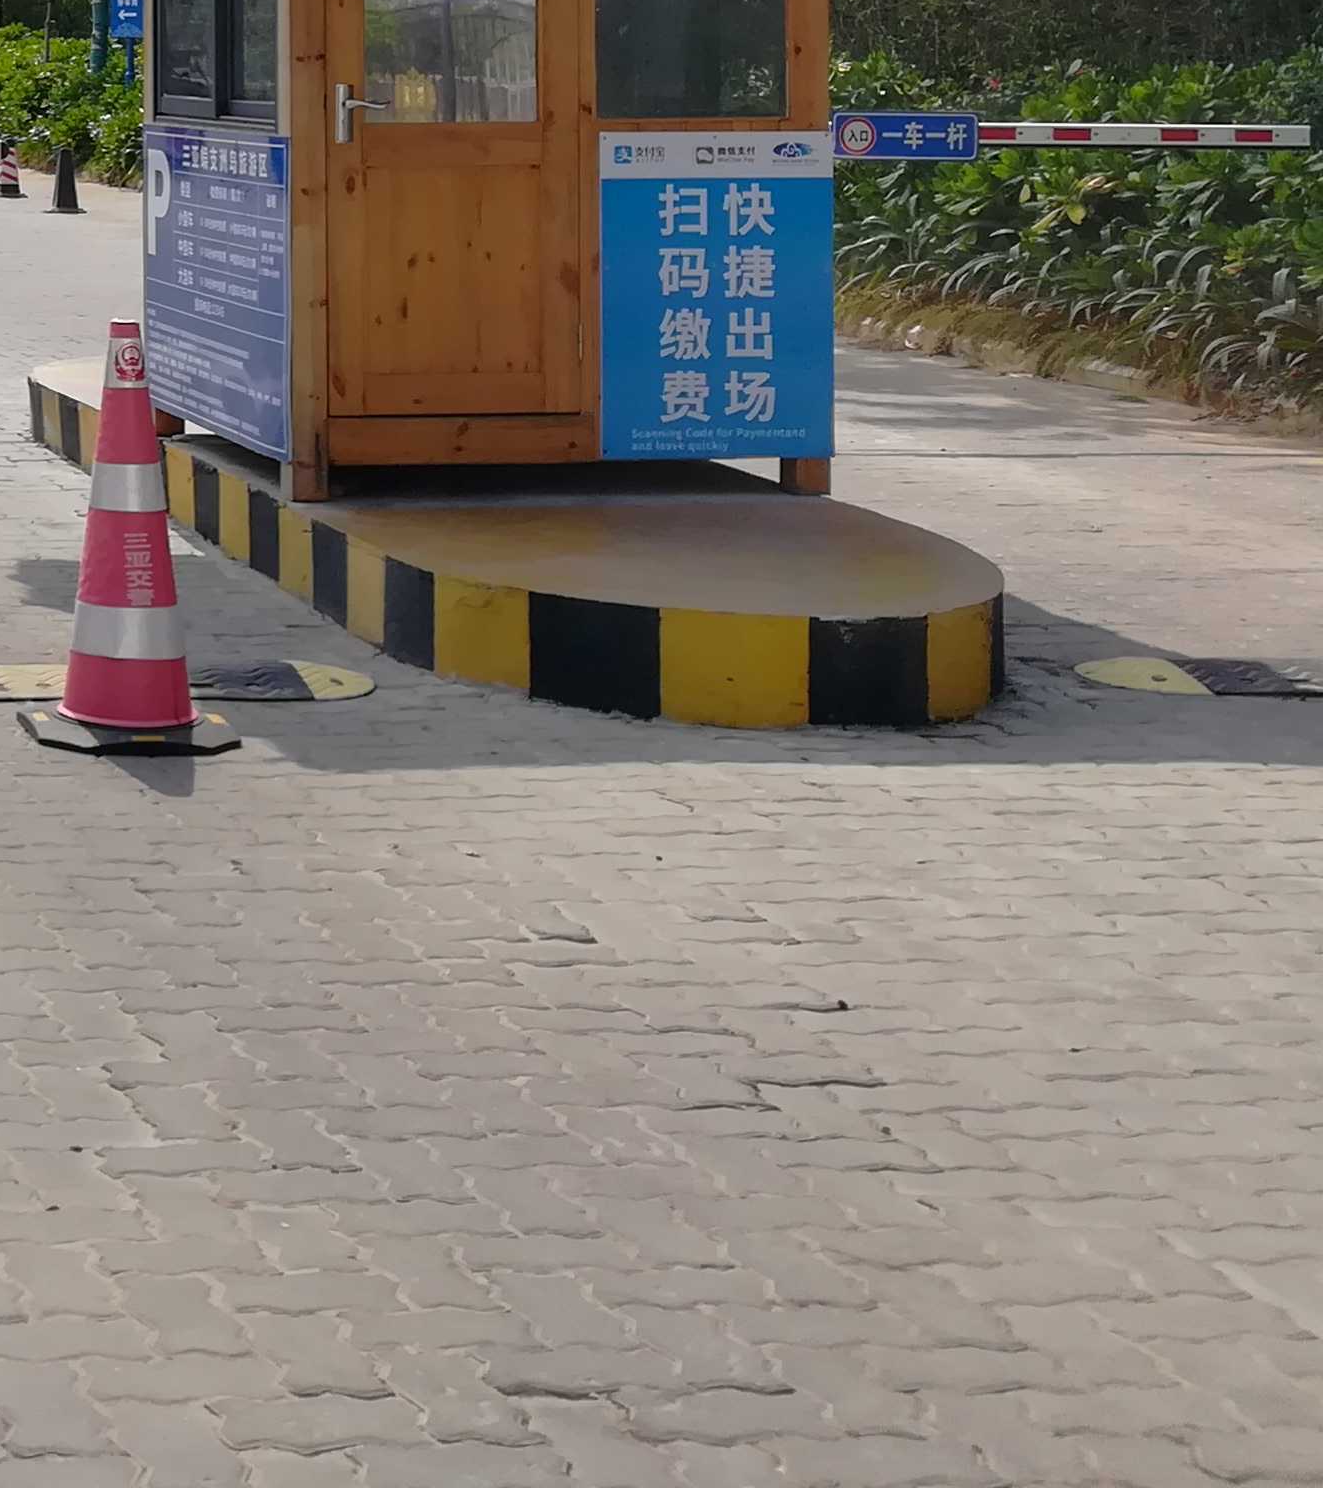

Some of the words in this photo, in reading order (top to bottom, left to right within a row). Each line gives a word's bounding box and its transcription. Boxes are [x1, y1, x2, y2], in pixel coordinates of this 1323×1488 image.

[848, 130, 869, 142] 入口
[881, 121, 968, 151] 一车一杆
[634, 146, 666, 158] 支付宝
[147, 148, 171, 256] P
[658, 183, 712, 423] 扫码缴费
[722, 182, 777, 423] 快捷出场
[631, 428, 682, 440] Scanning
[686, 427, 715, 439] Code
[717, 427, 733, 439] for
[631, 441, 653, 451] and
